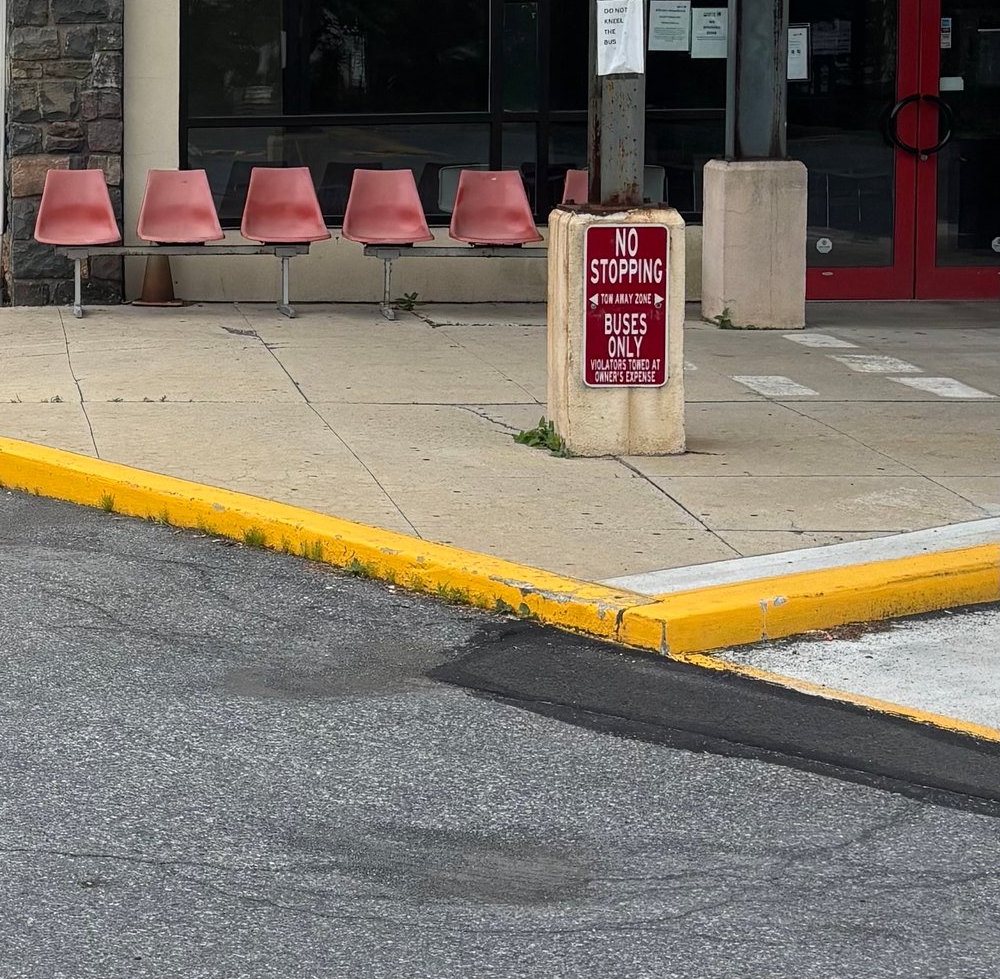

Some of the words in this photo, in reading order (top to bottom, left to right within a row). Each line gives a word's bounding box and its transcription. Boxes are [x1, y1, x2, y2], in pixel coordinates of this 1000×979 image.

[615, 228, 638, 257] NO
[590, 259, 663, 284] STOPPING
[601, 293, 614, 304] TOW
[615, 293, 634, 304] AWAY
[635, 293, 651, 304] ZONE
[604, 313, 648, 335] BUSES
[608, 336, 644, 358] ONLY
[590, 359, 627, 370] VIOLATORS
[628, 359, 650, 370] TOWED
[651, 359, 660, 370] AT
[595, 371, 624, 383] OWNER'S
[625, 371, 656, 383] EXPENSE
